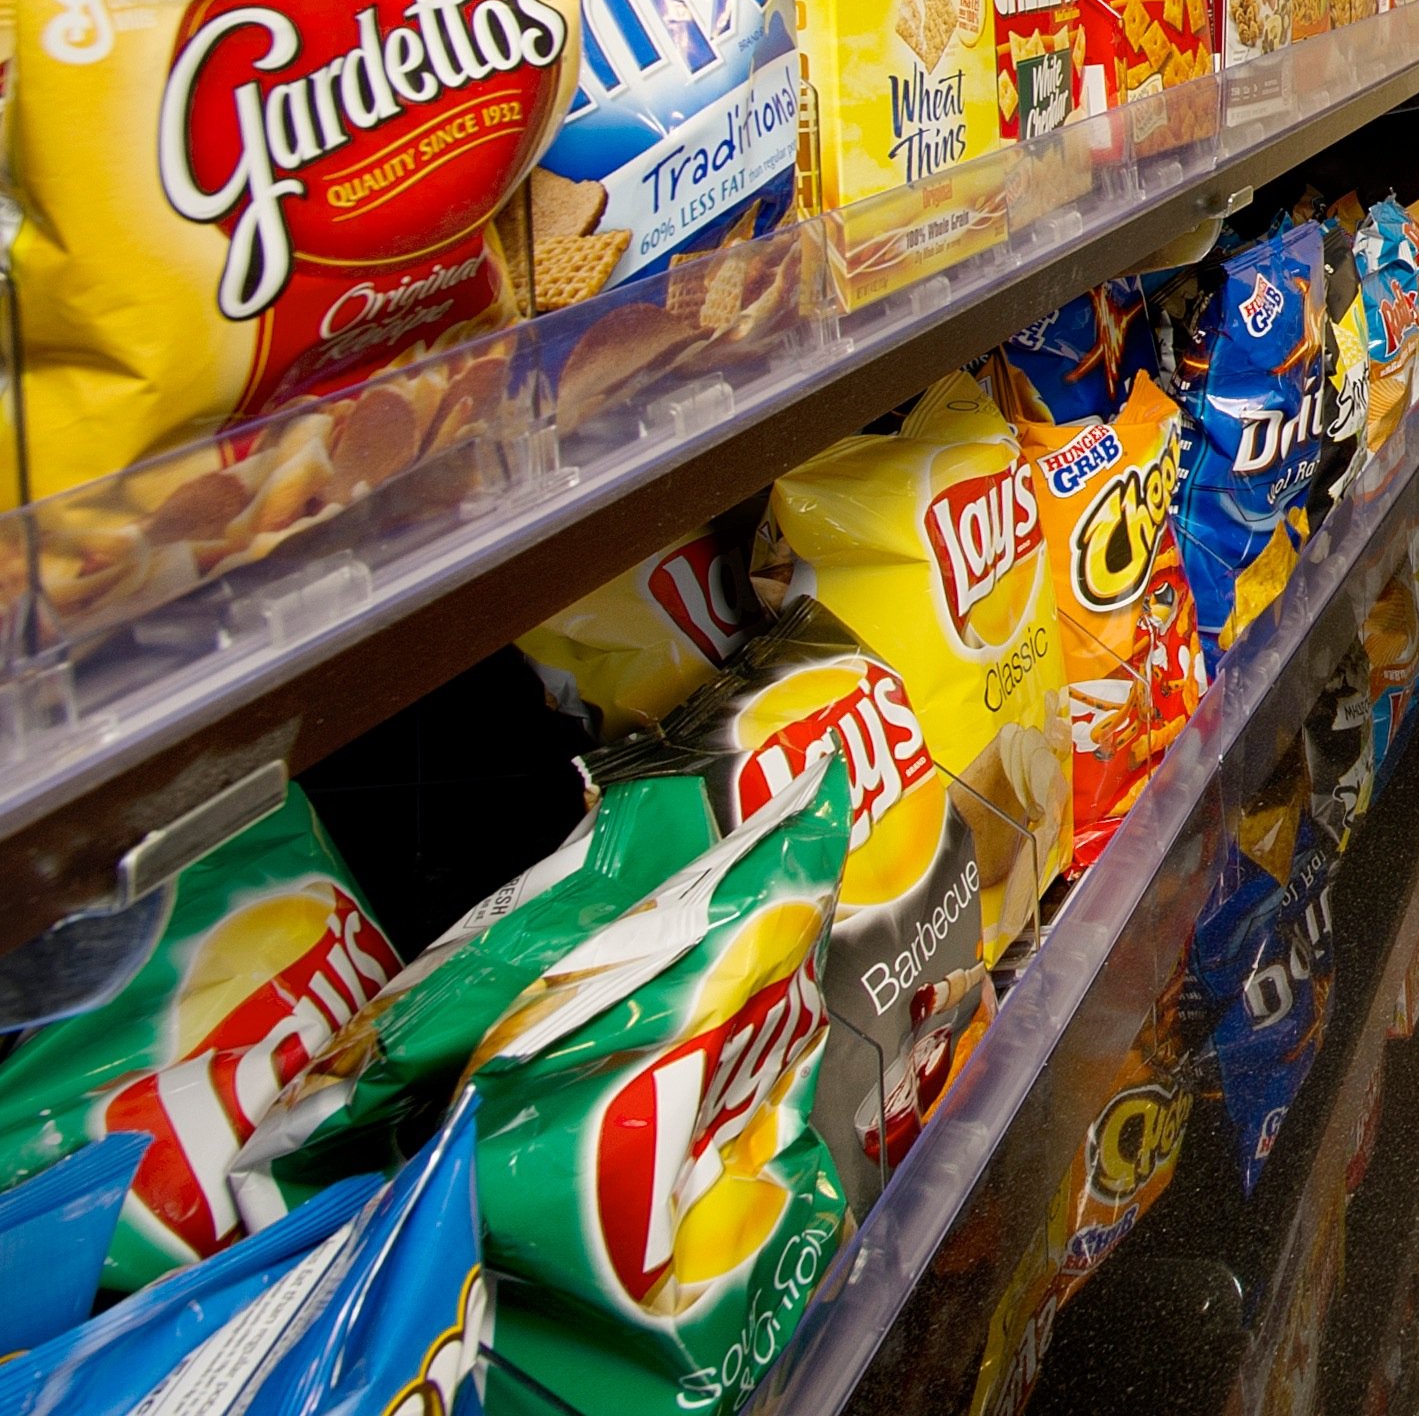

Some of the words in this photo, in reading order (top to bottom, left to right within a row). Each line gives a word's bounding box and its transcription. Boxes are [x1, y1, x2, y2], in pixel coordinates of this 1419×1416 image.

[888, 62, 967, 139] Wheat
[1031, 58, 1064, 108] White
[327, 150, 417, 210] QUALITY
[417, 117, 479, 159] SINCE
[482, 100, 523, 131] 1932
[642, 81, 798, 216] Traditional
[887, 123, 967, 188] Thins
[639, 216, 676, 257] 60%
[680, 185, 716, 231] LESS
[717, 170, 748, 208] FAT
[927, 216, 950, 243] Whole
[949, 210, 971, 238] Grain
[321, 253, 487, 342] Original
[1042, 424, 1111, 473] HUNGER
[1053, 434, 1121, 495] GRAB
[933, 451, 1039, 619] Lay's
[983, 624, 1051, 714] Classic
[860, 858, 981, 1018] Barbecue
